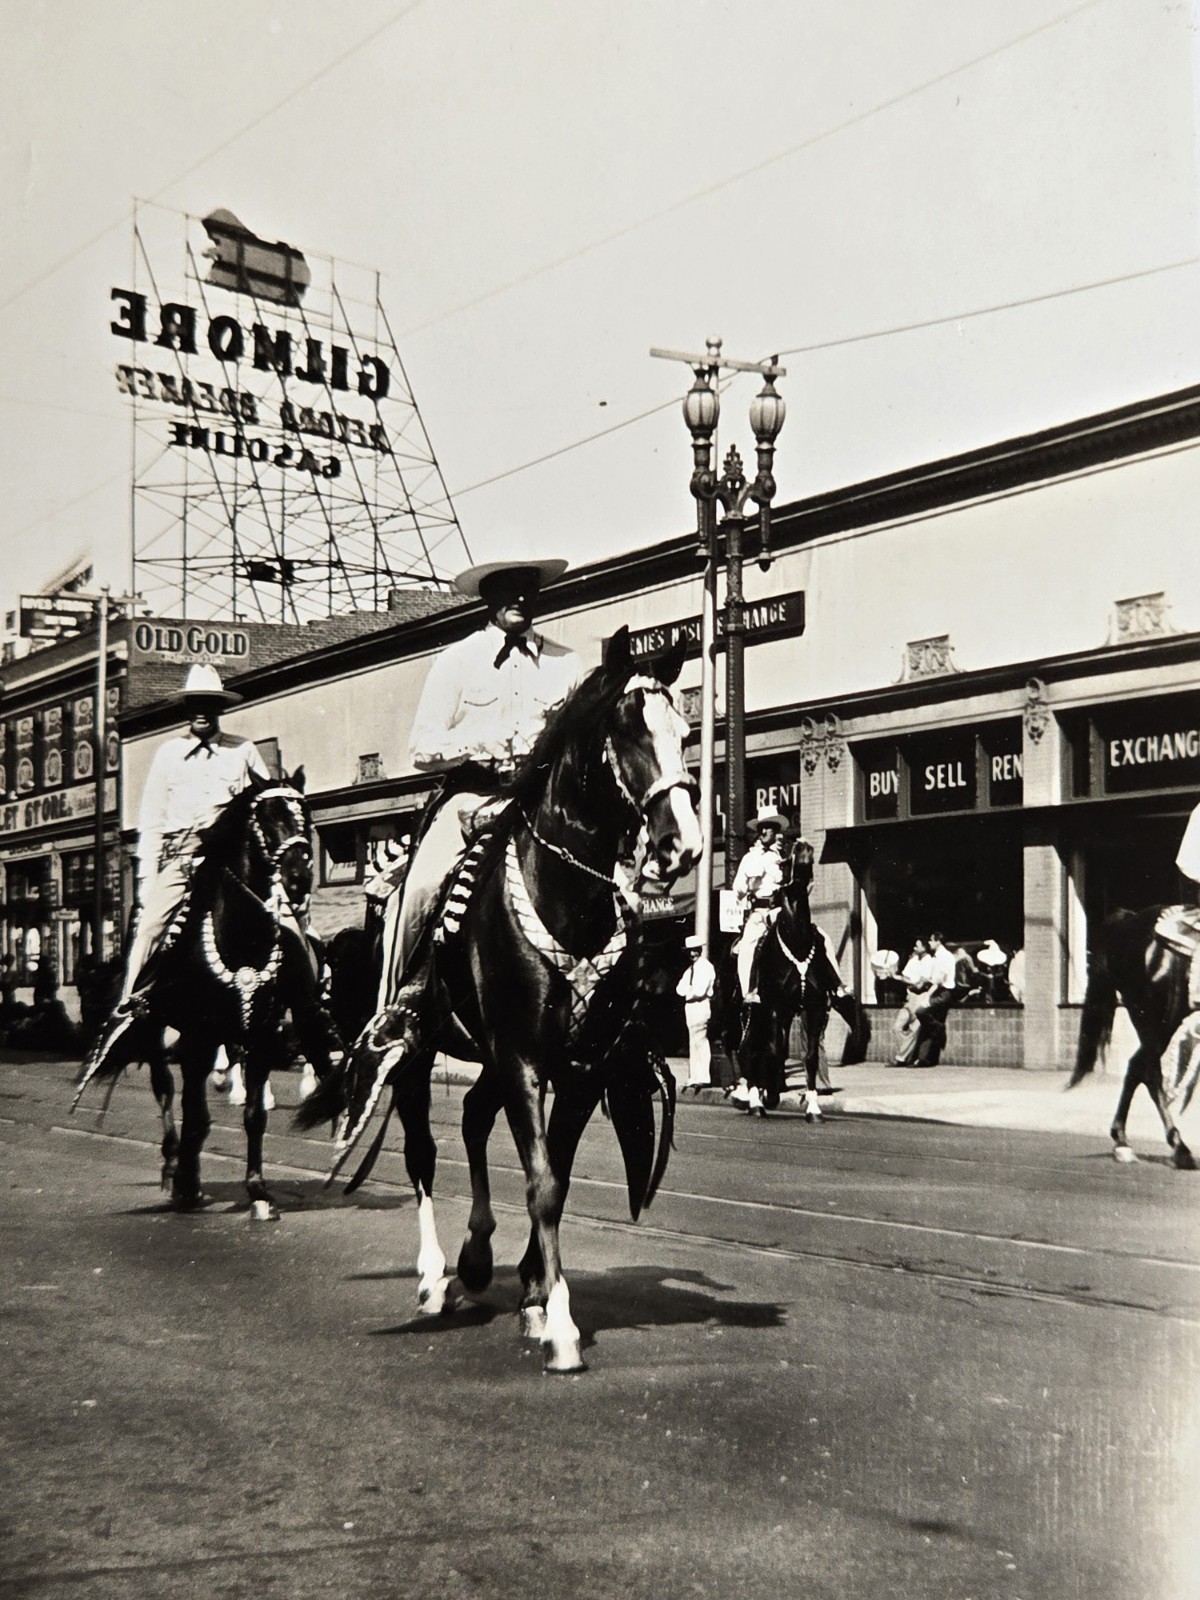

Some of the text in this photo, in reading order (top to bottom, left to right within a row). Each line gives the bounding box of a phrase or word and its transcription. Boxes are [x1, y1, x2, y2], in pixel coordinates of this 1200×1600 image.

[716, 601, 787, 636] EHANGE
[1110, 729, 1200, 767] EXCHANG
[870, 754, 1023, 797] BUY SELL REN
[756, 783, 801, 811] RENT
[641, 897, 674, 913] HANGE
